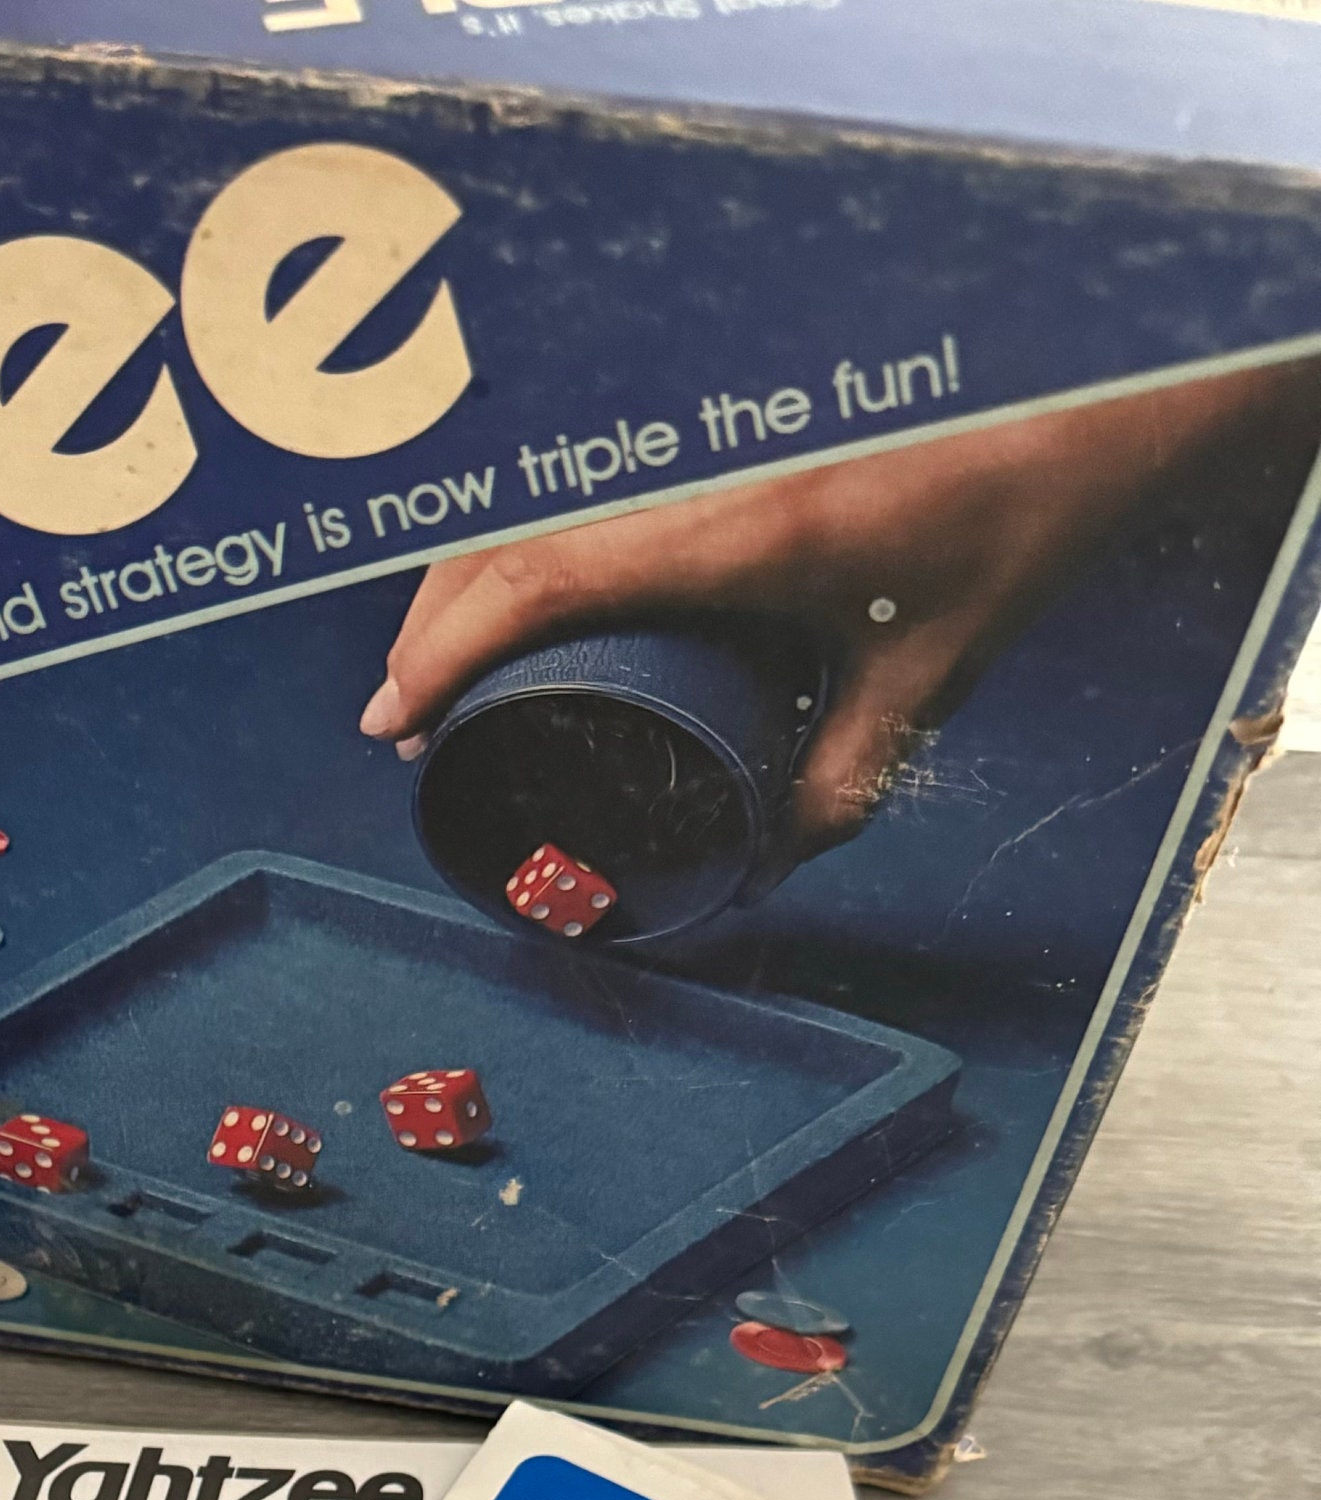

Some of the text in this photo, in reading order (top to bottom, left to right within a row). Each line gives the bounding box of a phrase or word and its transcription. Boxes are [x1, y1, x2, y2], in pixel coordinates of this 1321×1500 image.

[60, 521, 287, 622] strategy
[302, 501, 352, 553] is
[367, 465, 496, 537] now
[518, 419, 680, 496] triple
[699, 385, 812, 453] the
[833, 334, 961, 419] fun!
